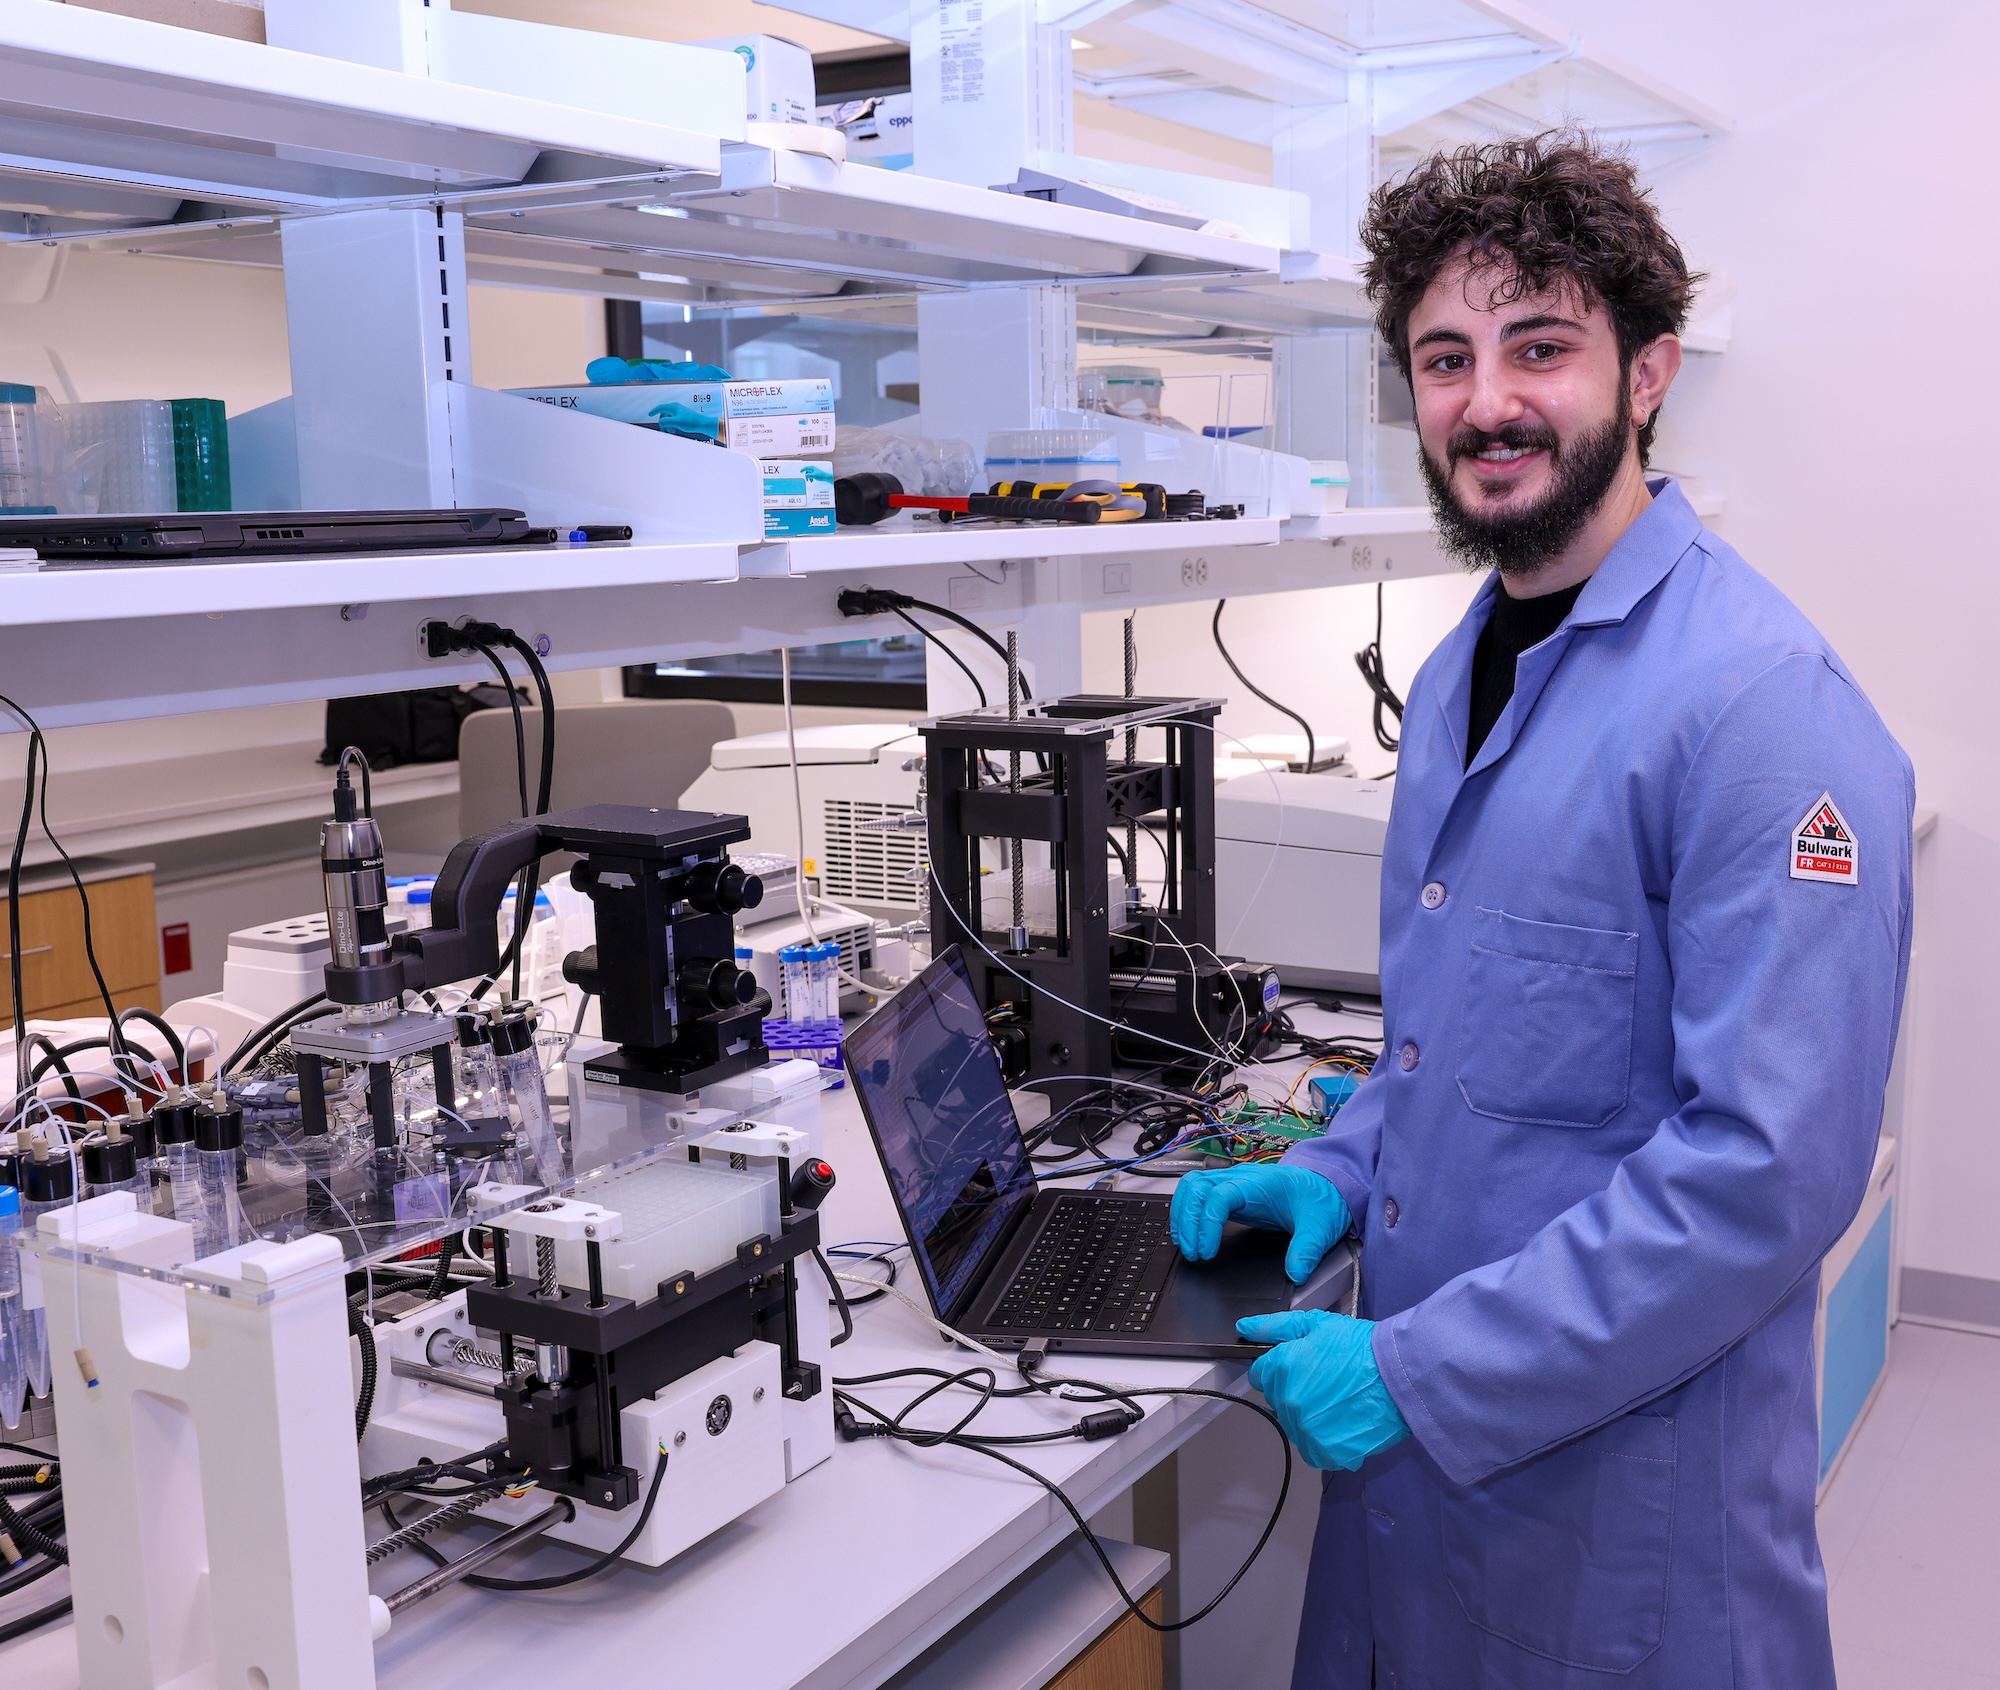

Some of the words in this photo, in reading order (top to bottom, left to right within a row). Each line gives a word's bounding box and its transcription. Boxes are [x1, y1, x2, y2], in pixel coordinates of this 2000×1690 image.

[729, 386, 783, 398] MICROFLEX
[810, 515, 829, 525] Ansell
[1797, 840, 1852, 858] Bulwark
[1800, 858, 1814, 868] FR
[336, 911, 347, 954] Dino-Lite
